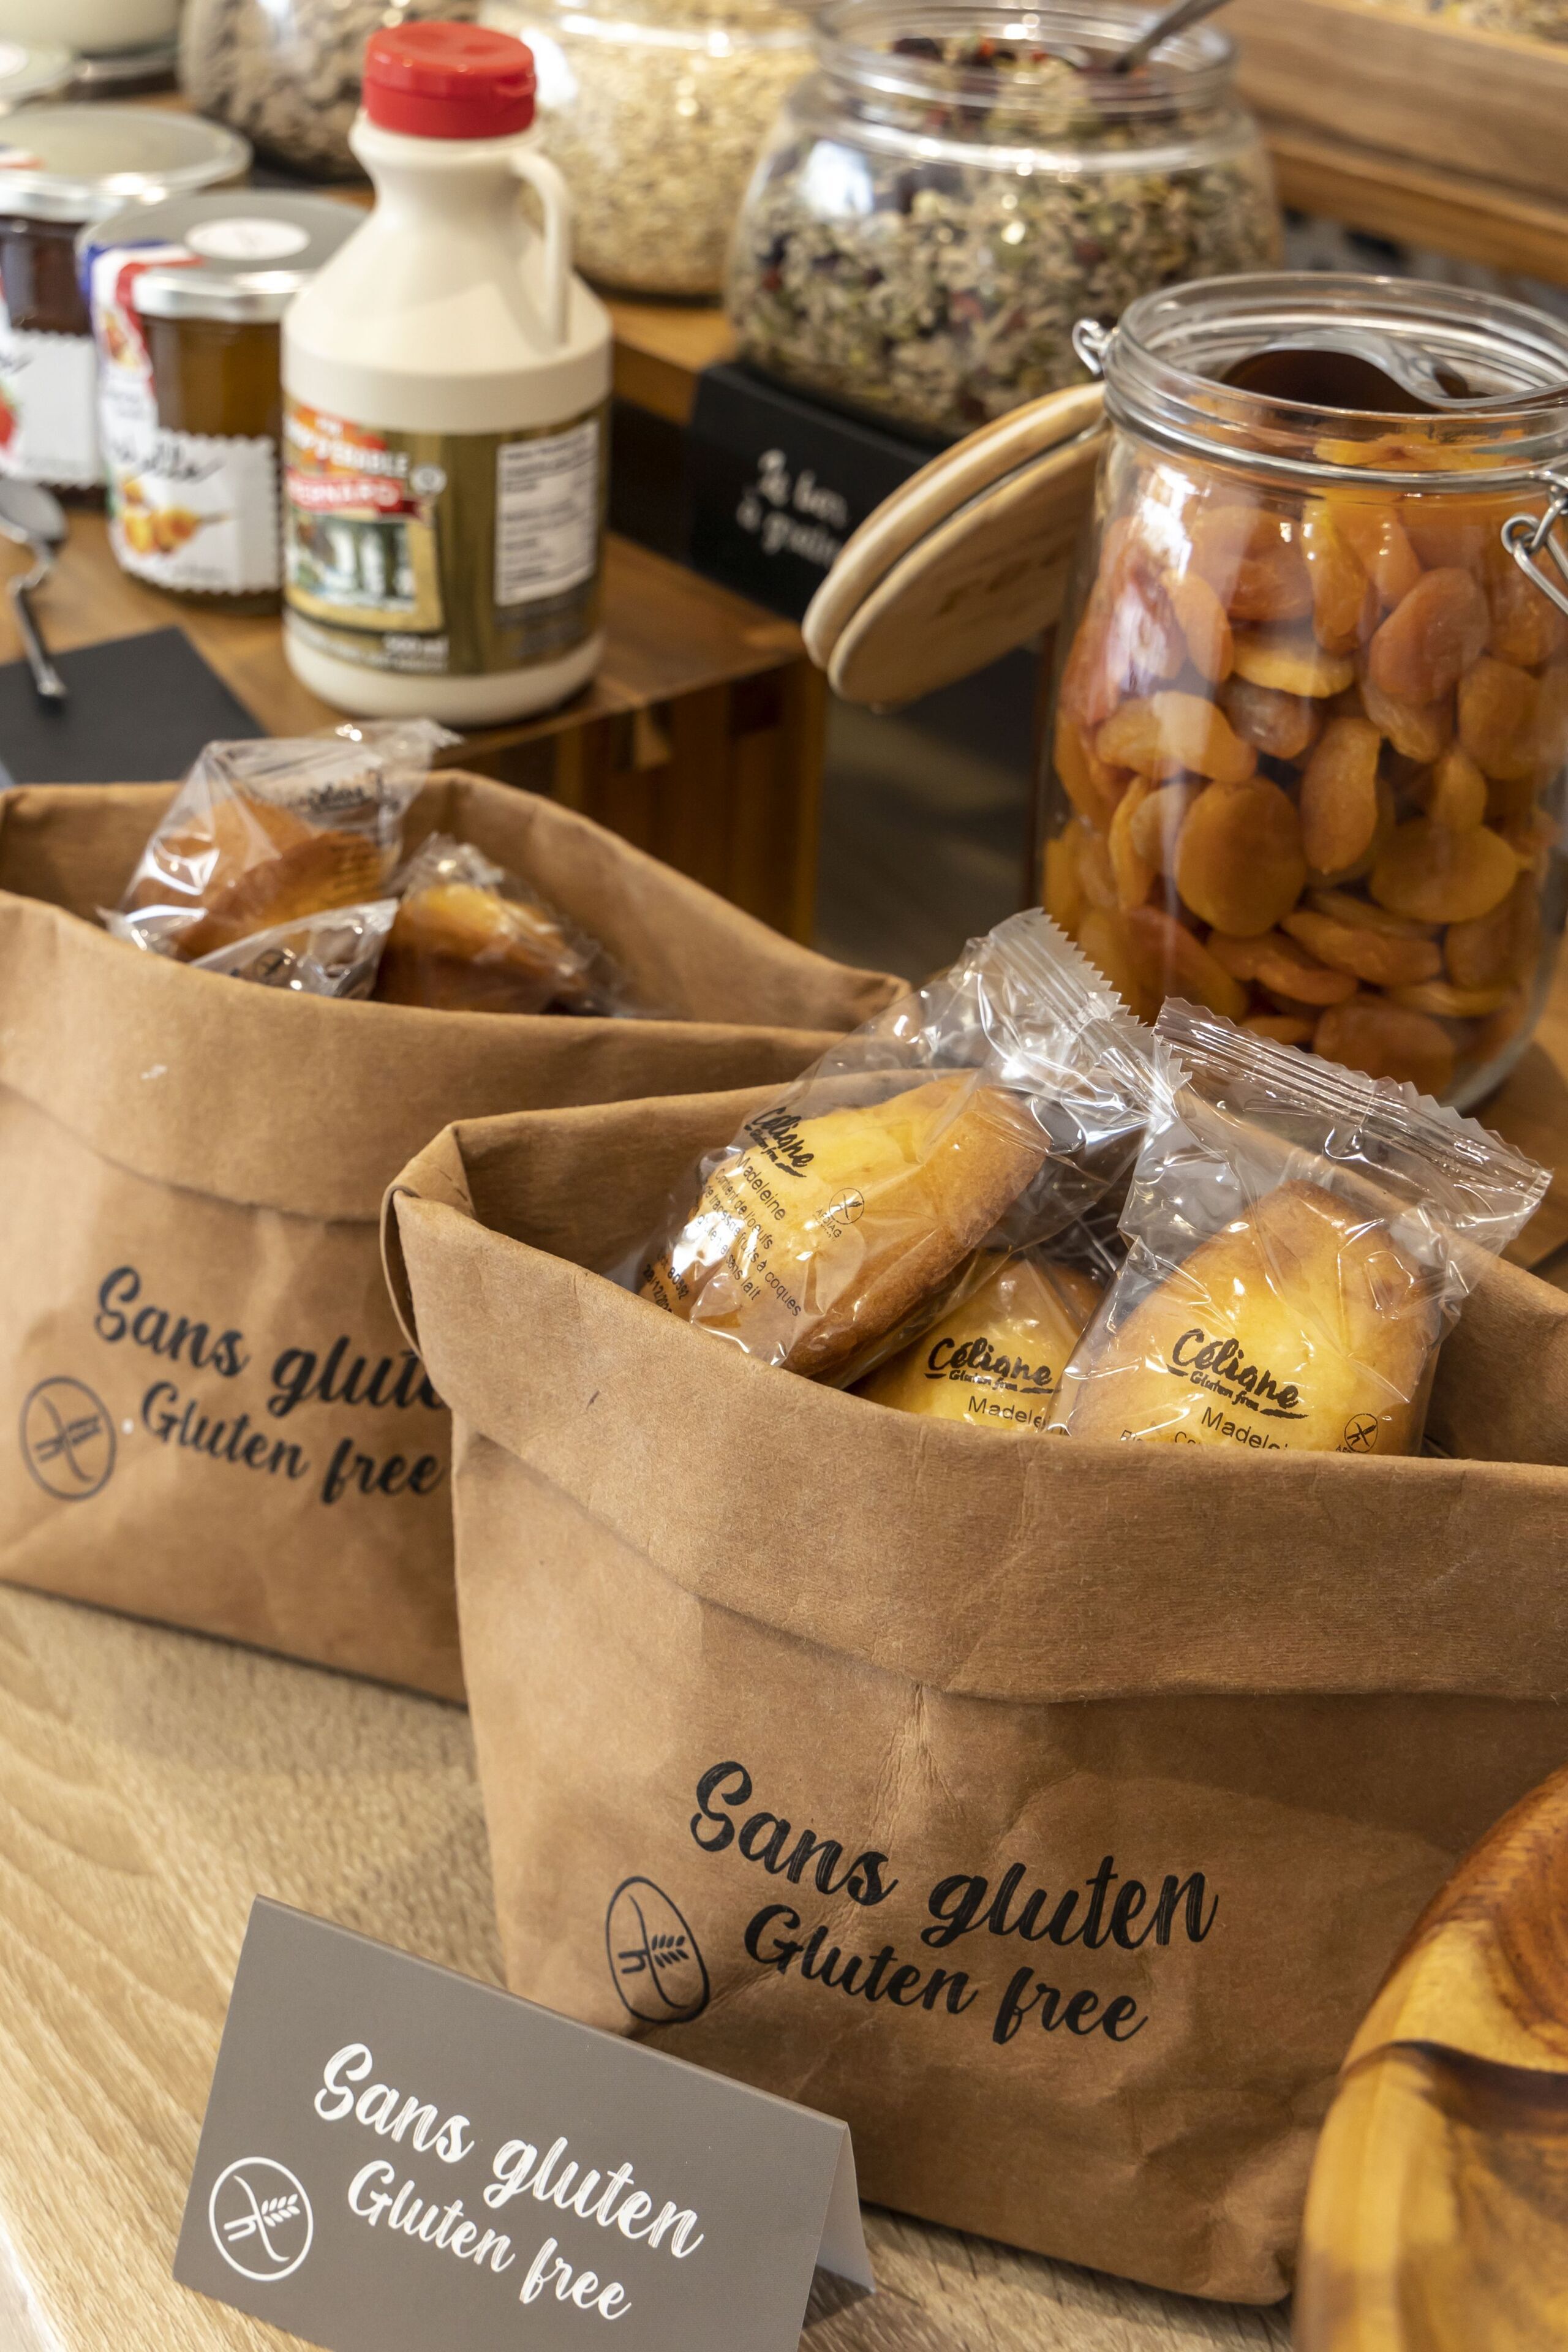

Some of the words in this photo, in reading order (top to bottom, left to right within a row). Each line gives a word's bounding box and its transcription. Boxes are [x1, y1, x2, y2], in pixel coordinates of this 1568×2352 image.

[734, 1199, 747, 1215] de
[735, 1151, 786, 1221] Madeleine
[94, 1265, 250, 1378] Sans
[267, 1335, 453, 1417] glut
[741, 1276, 762, 1300] lait
[764, 1271, 802, 1317] coques
[141, 1381, 309, 1480] Gluten
[320, 1438, 444, 1505] free
[690, 1760, 898, 1906] Sans
[920, 1855, 1219, 1950] gluten
[744, 1902, 978, 2015] Gluten
[992, 1966, 1150, 2045] free
[314, 2043, 475, 2164] Sans
[483, 2137, 705, 2259] gluten
[347, 2160, 516, 2274] Gluten
[519, 2237, 633, 2321] free
